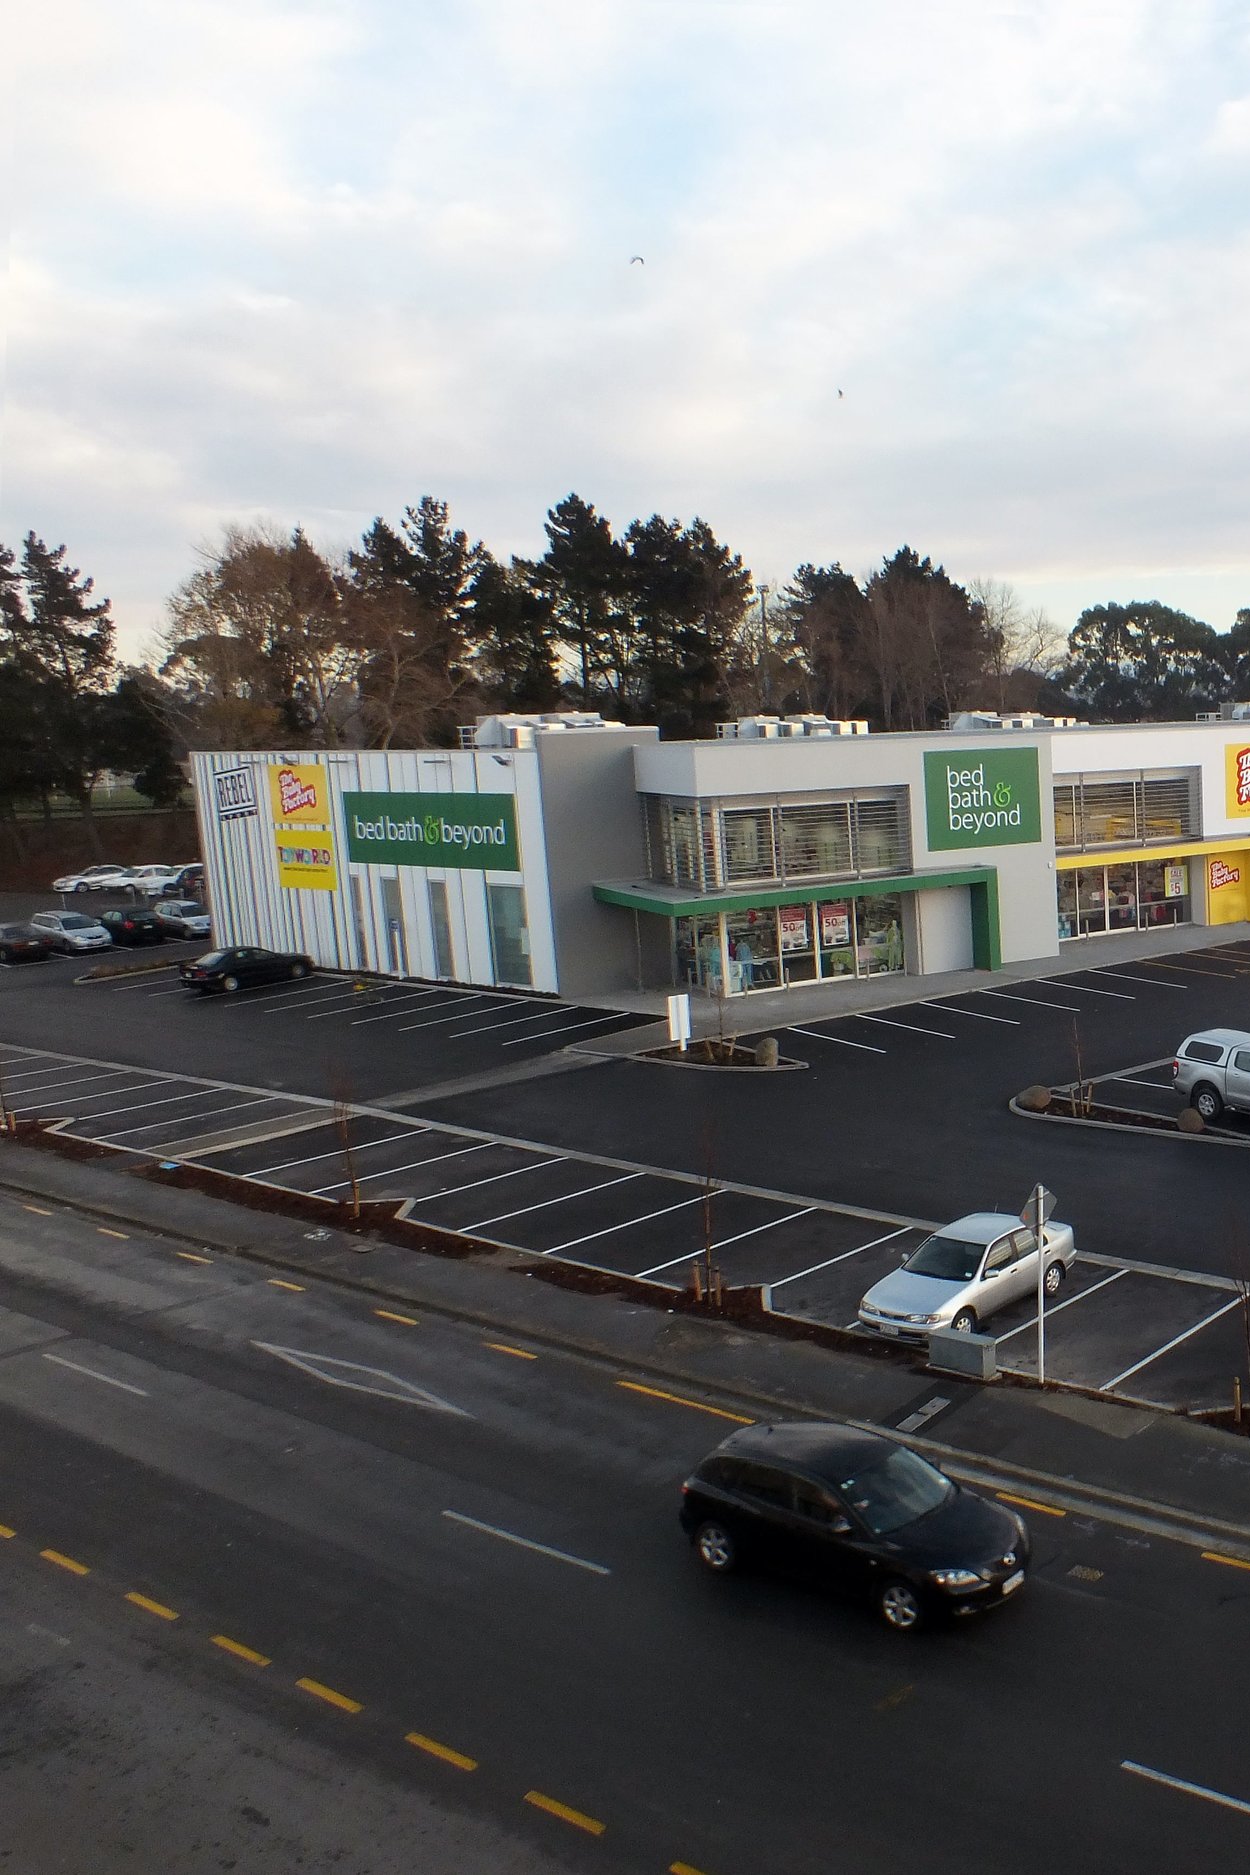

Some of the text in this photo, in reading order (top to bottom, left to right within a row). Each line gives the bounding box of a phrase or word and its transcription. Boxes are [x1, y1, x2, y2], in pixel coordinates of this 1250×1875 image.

[946, 763, 984, 788] bed
[217, 773, 252, 807] REBEL
[948, 782, 1012, 809] bath &
[353, 814, 506, 850] bed bath & beyond
[949, 803, 1021, 835] beyond
[1212, 870, 1239, 888] Factory
[782, 922, 796, 932] 50
[825, 918, 838, 927] 50
